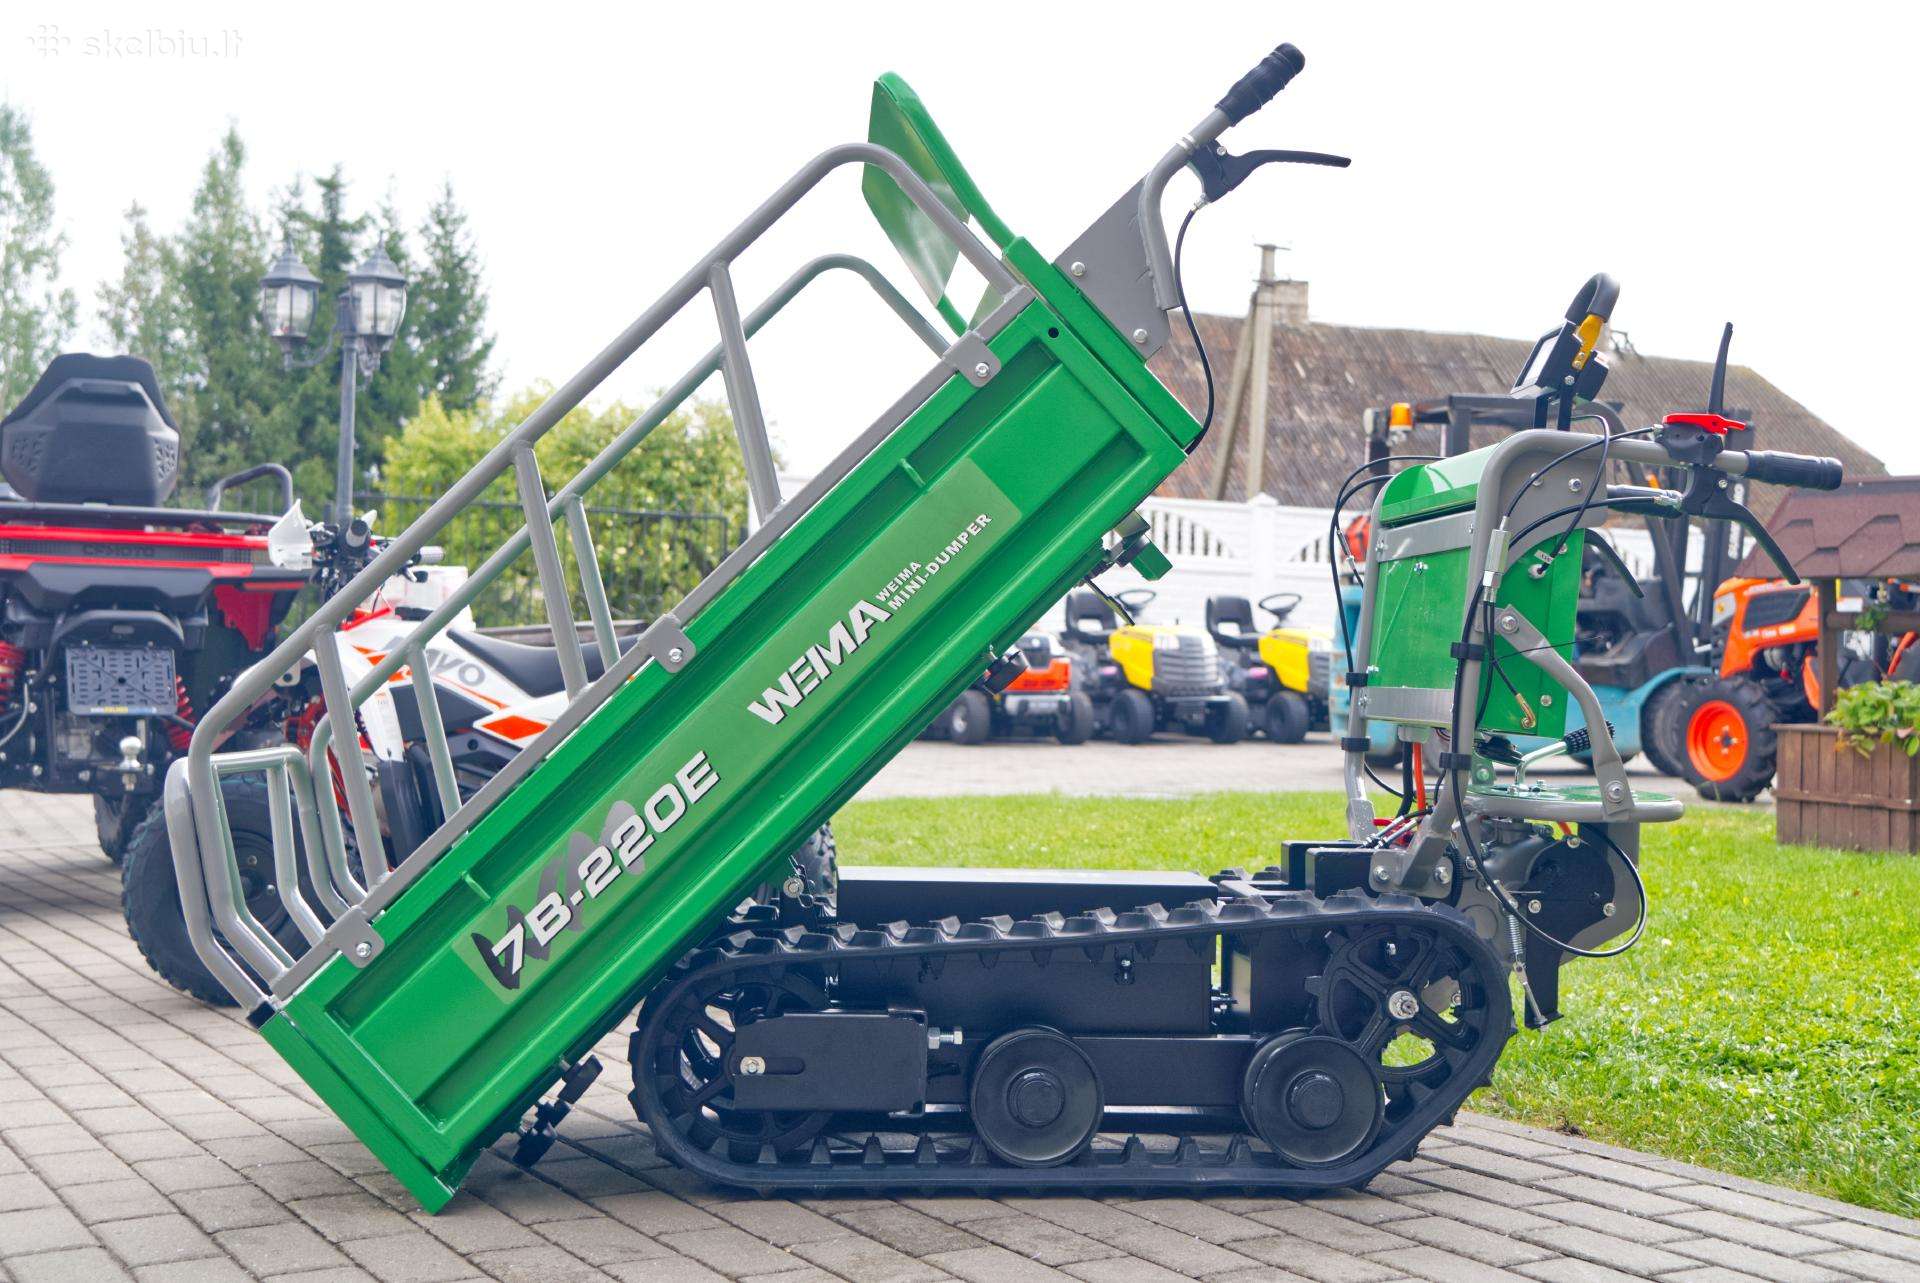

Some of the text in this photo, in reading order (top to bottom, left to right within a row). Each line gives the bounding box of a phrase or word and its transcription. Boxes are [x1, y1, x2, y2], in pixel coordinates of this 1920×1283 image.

[876, 561, 922, 602] WEIMA
[888, 513, 993, 611] MINI-DUMPER
[747, 599, 893, 725] WEIMA
[491, 749, 721, 976] 7B-220E
